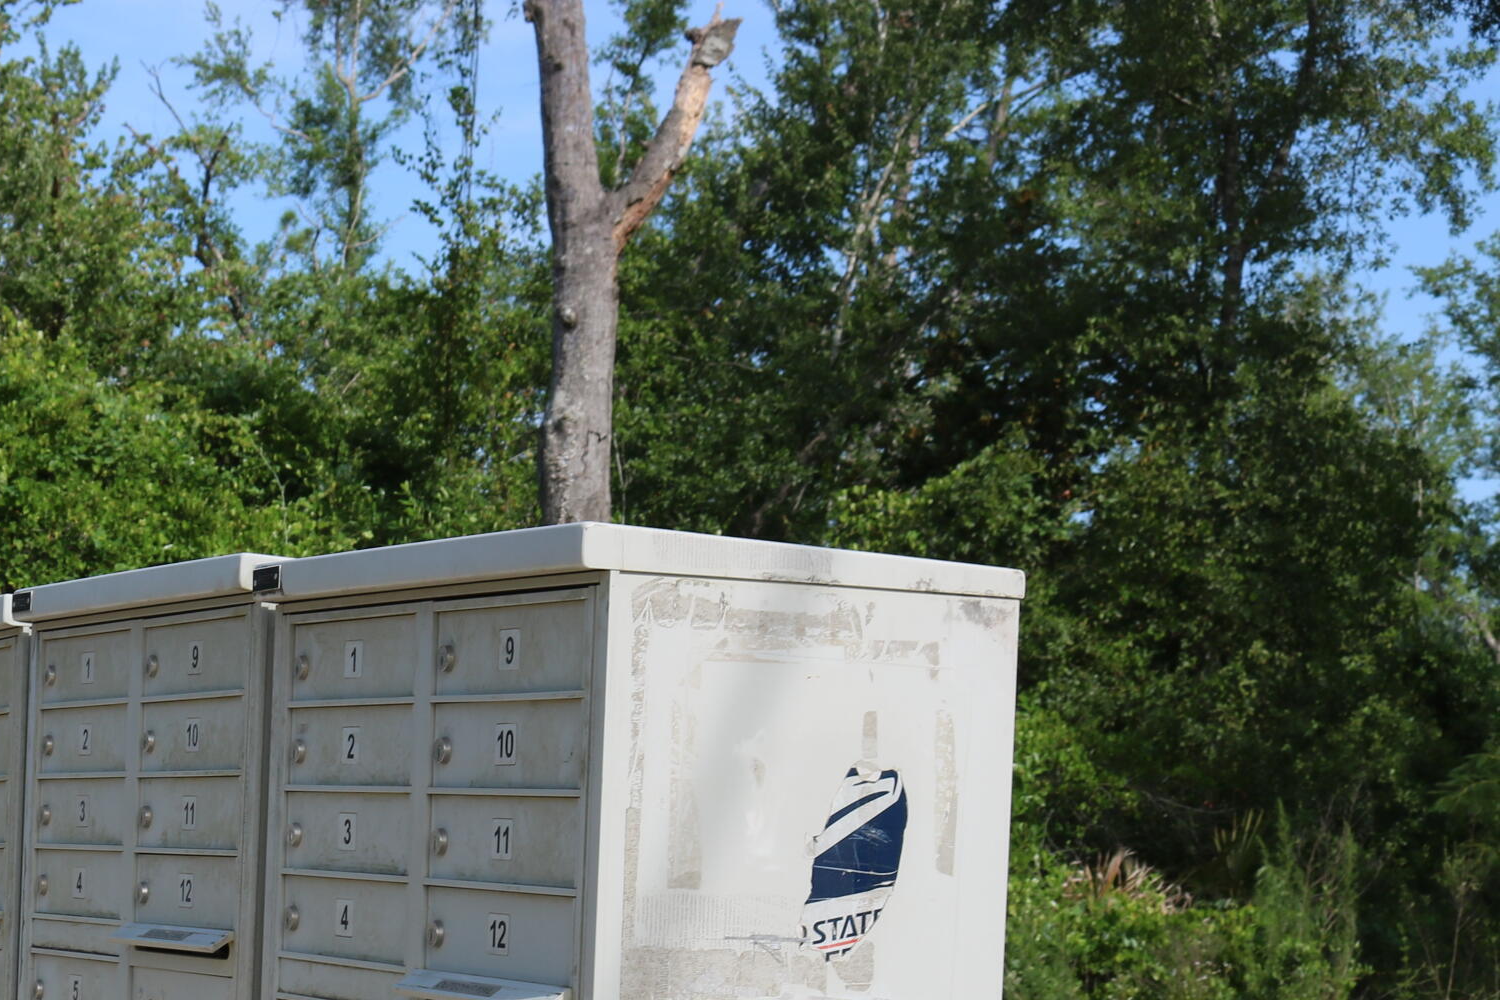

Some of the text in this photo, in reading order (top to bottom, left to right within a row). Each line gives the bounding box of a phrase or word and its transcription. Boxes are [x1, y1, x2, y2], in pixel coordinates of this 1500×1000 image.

[191, 645, 199, 669] 9
[350, 647, 357, 673] 1
[505, 636, 515, 665] 9
[85, 658, 91, 679] 1
[82, 728, 89, 751] 2
[186, 723, 199, 747] 10
[346, 733, 355, 760] 2
[497, 729, 514, 759] 10
[79, 800, 86, 822] 3
[183, 802, 195, 825] 11
[343, 818, 352, 845] 3
[494, 825, 510, 854] 11
[76, 872, 83, 893] 4
[180, 879, 192, 903] 12
[340, 904, 349, 931] 4
[489, 919, 507, 949] 12
